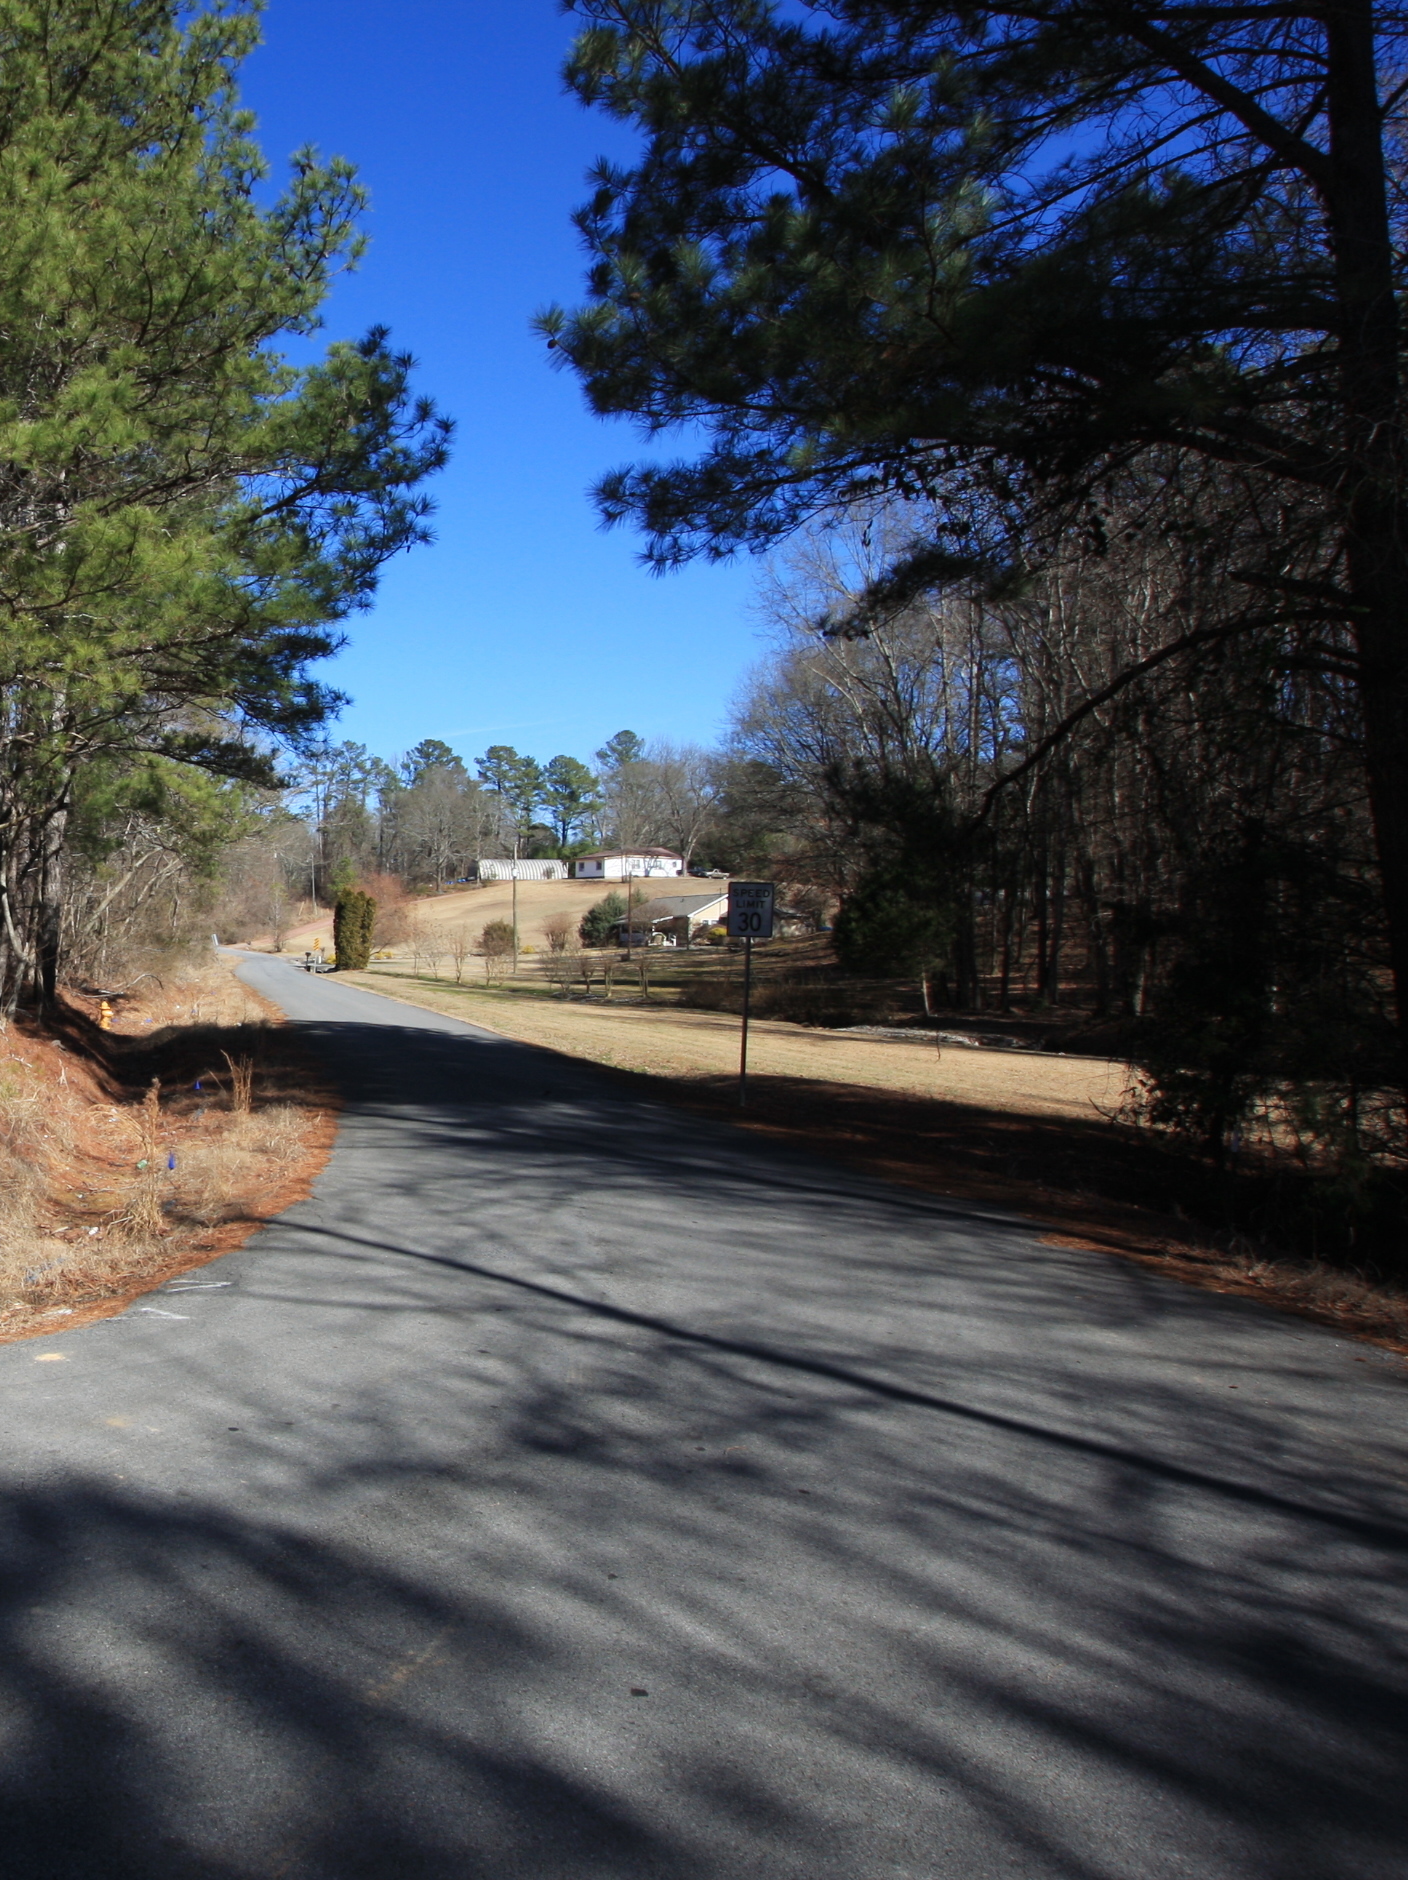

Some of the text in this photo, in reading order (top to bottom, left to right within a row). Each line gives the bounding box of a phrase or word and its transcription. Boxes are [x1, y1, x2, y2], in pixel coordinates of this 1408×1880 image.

[732, 888, 770, 898] SPEED
[735, 900, 766, 909] LIMIT
[737, 911, 762, 932] 30
